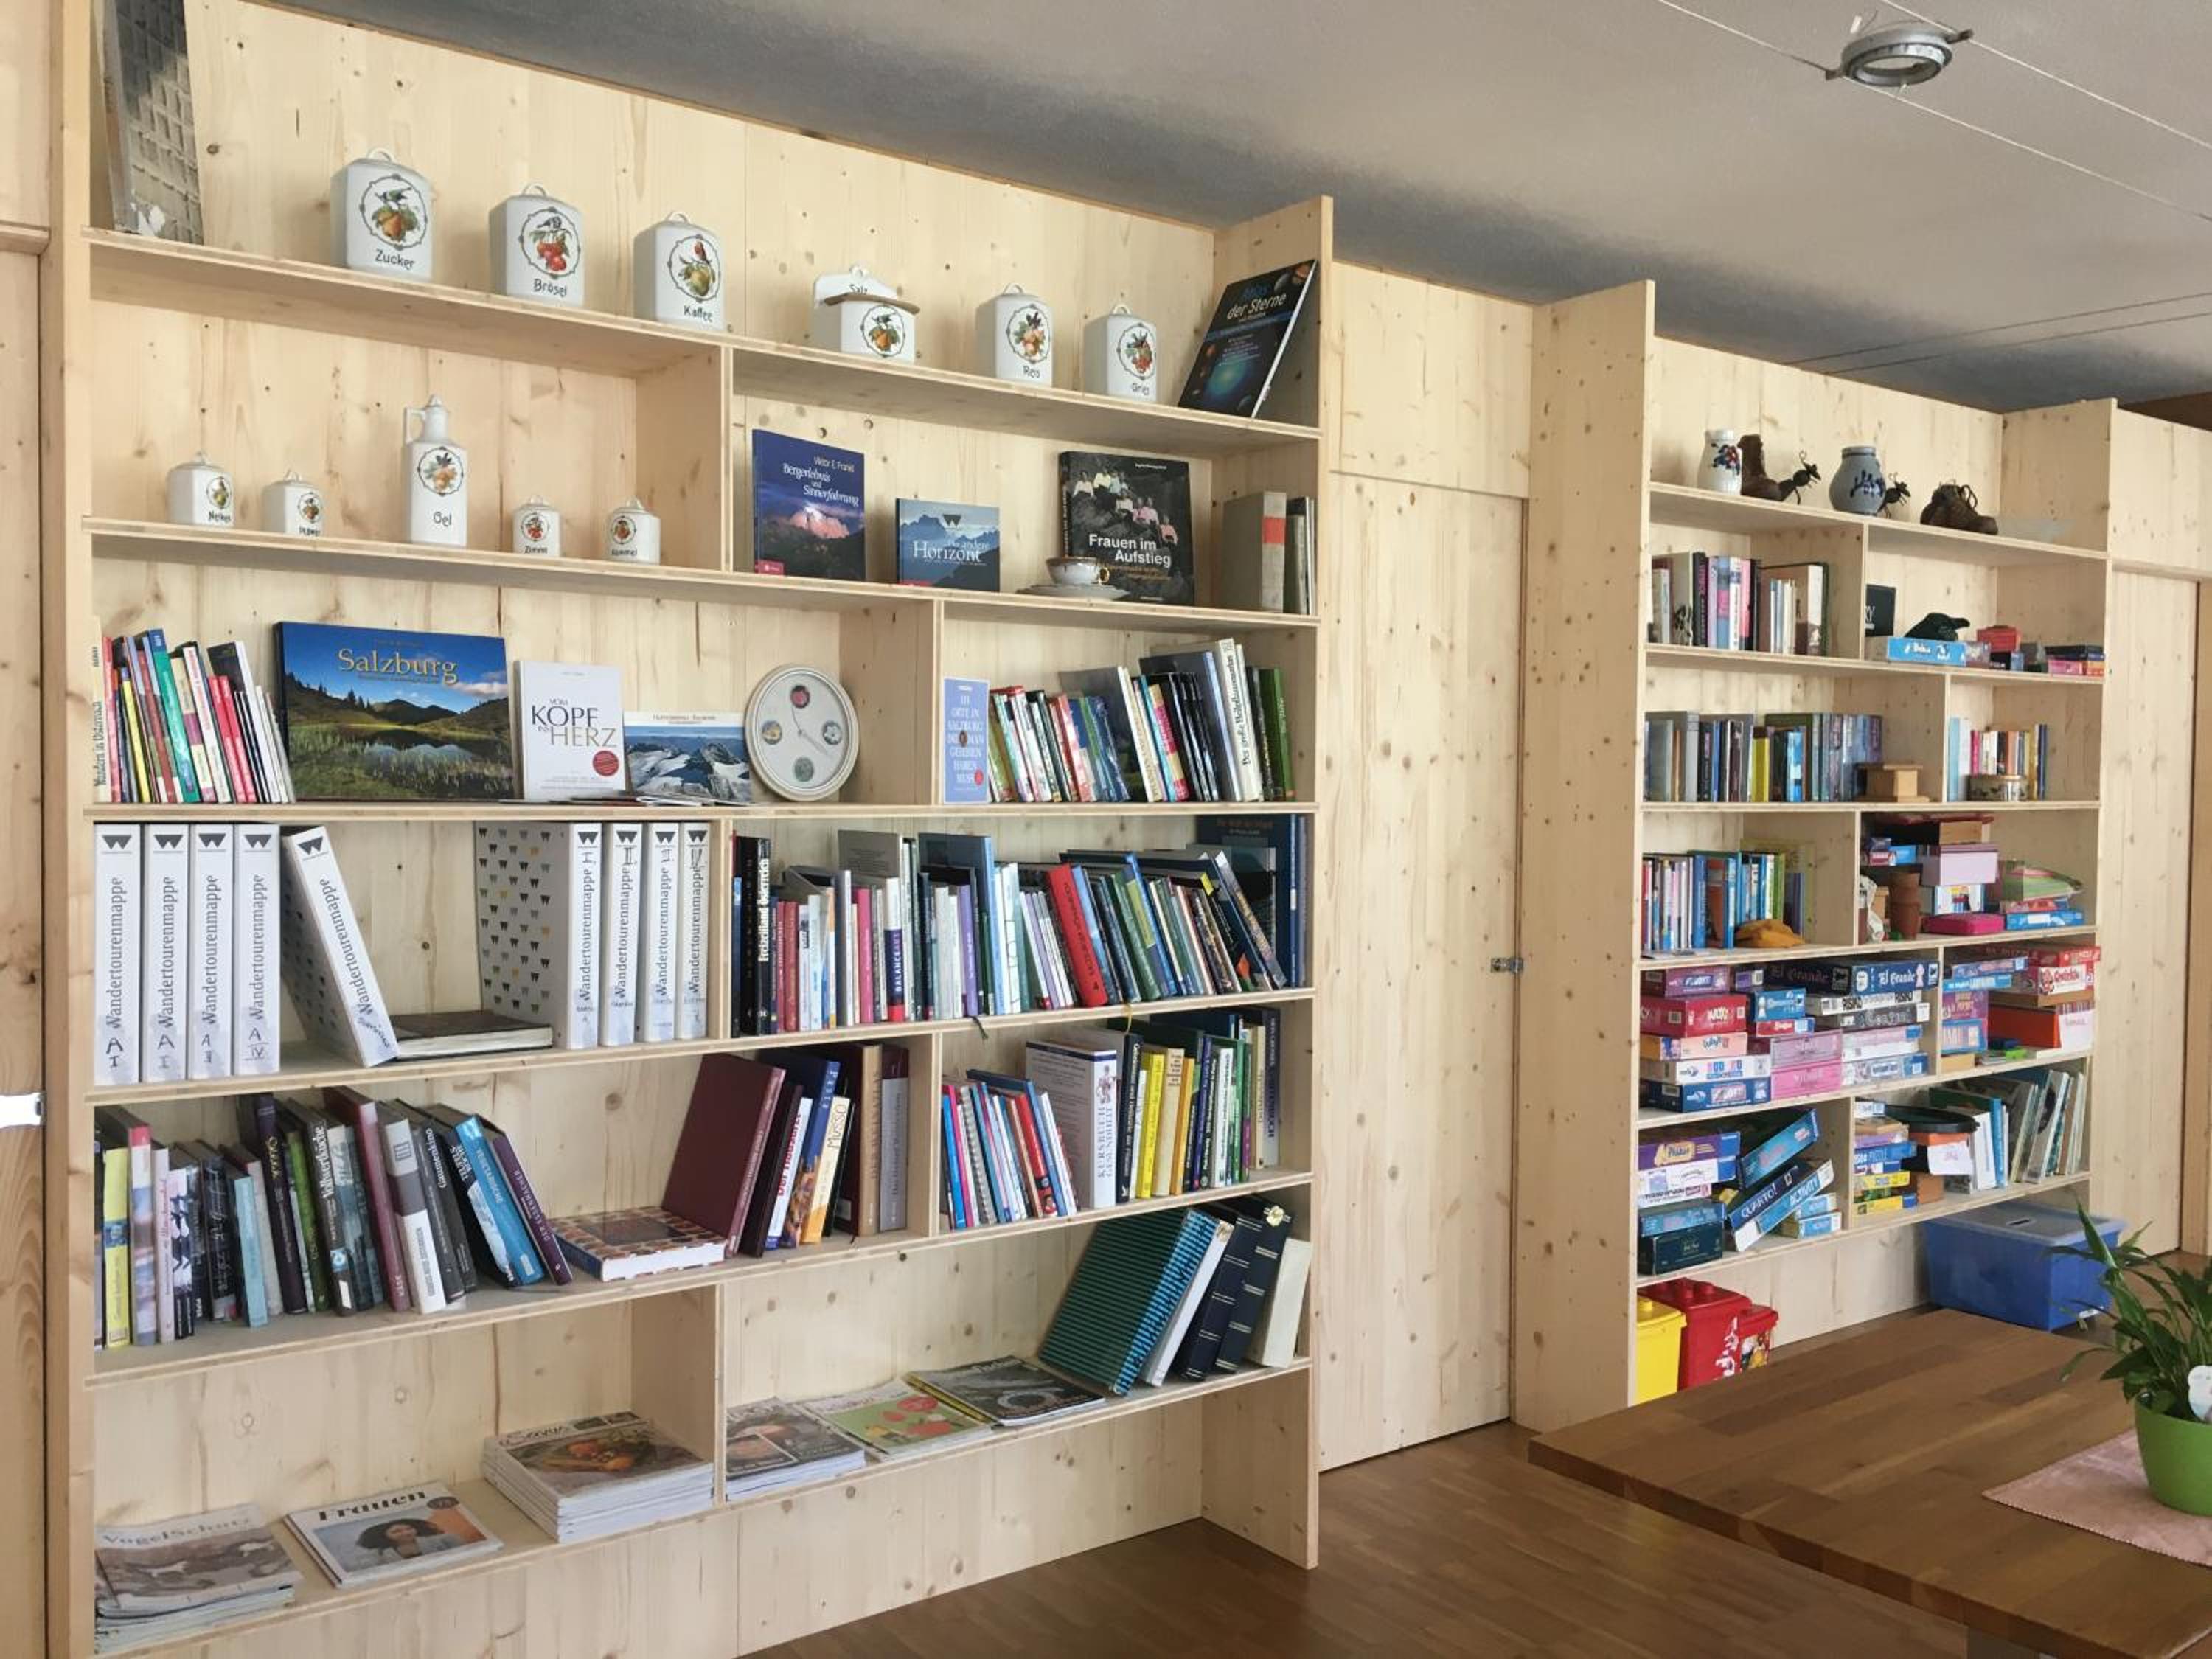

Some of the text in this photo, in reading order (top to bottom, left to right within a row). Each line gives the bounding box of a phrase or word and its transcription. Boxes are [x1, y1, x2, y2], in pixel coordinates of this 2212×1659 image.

[375, 248, 414, 271] Zucker
[533, 278, 568, 297] Brösel
[683, 305, 714, 323] Kaffee
[1227, 302, 1248, 319] der
[1247, 293, 1287, 316] Sterne
[783, 462, 831, 483] Bergerlebnis
[913, 540, 982, 563] Horizont
[1088, 534, 1157, 551] Frauen im
[1114, 550, 1172, 569] Aufstieg
[337, 647, 459, 685] Salzburg
[531, 704, 599, 728] KOPF
[550, 726, 618, 748] HERZ
[579, 869, 596, 1001] Wandertourenmappe
[614, 864, 634, 999] Wandertourenmappe
[654, 866, 670, 998] Wandertourenmappe
[689, 865, 705, 995] Wandertourenmappe
[106, 877, 128, 1029] Wandertourenmappe
[158, 876, 178, 1029] Wandertourenmappe
[202, 874, 221, 1026] Wandertourenmappe
[248, 874, 268, 1020] Wandertourenmappe
[319, 877, 373, 1015] Wandertourenmappe
[1879, 968, 1916, 986] El Grande
[105, 1037, 125, 1054] A
[157, 1034, 175, 1051] A
[248, 1027, 264, 1043] A
[314, 1125, 335, 1198] Vollwertküche
